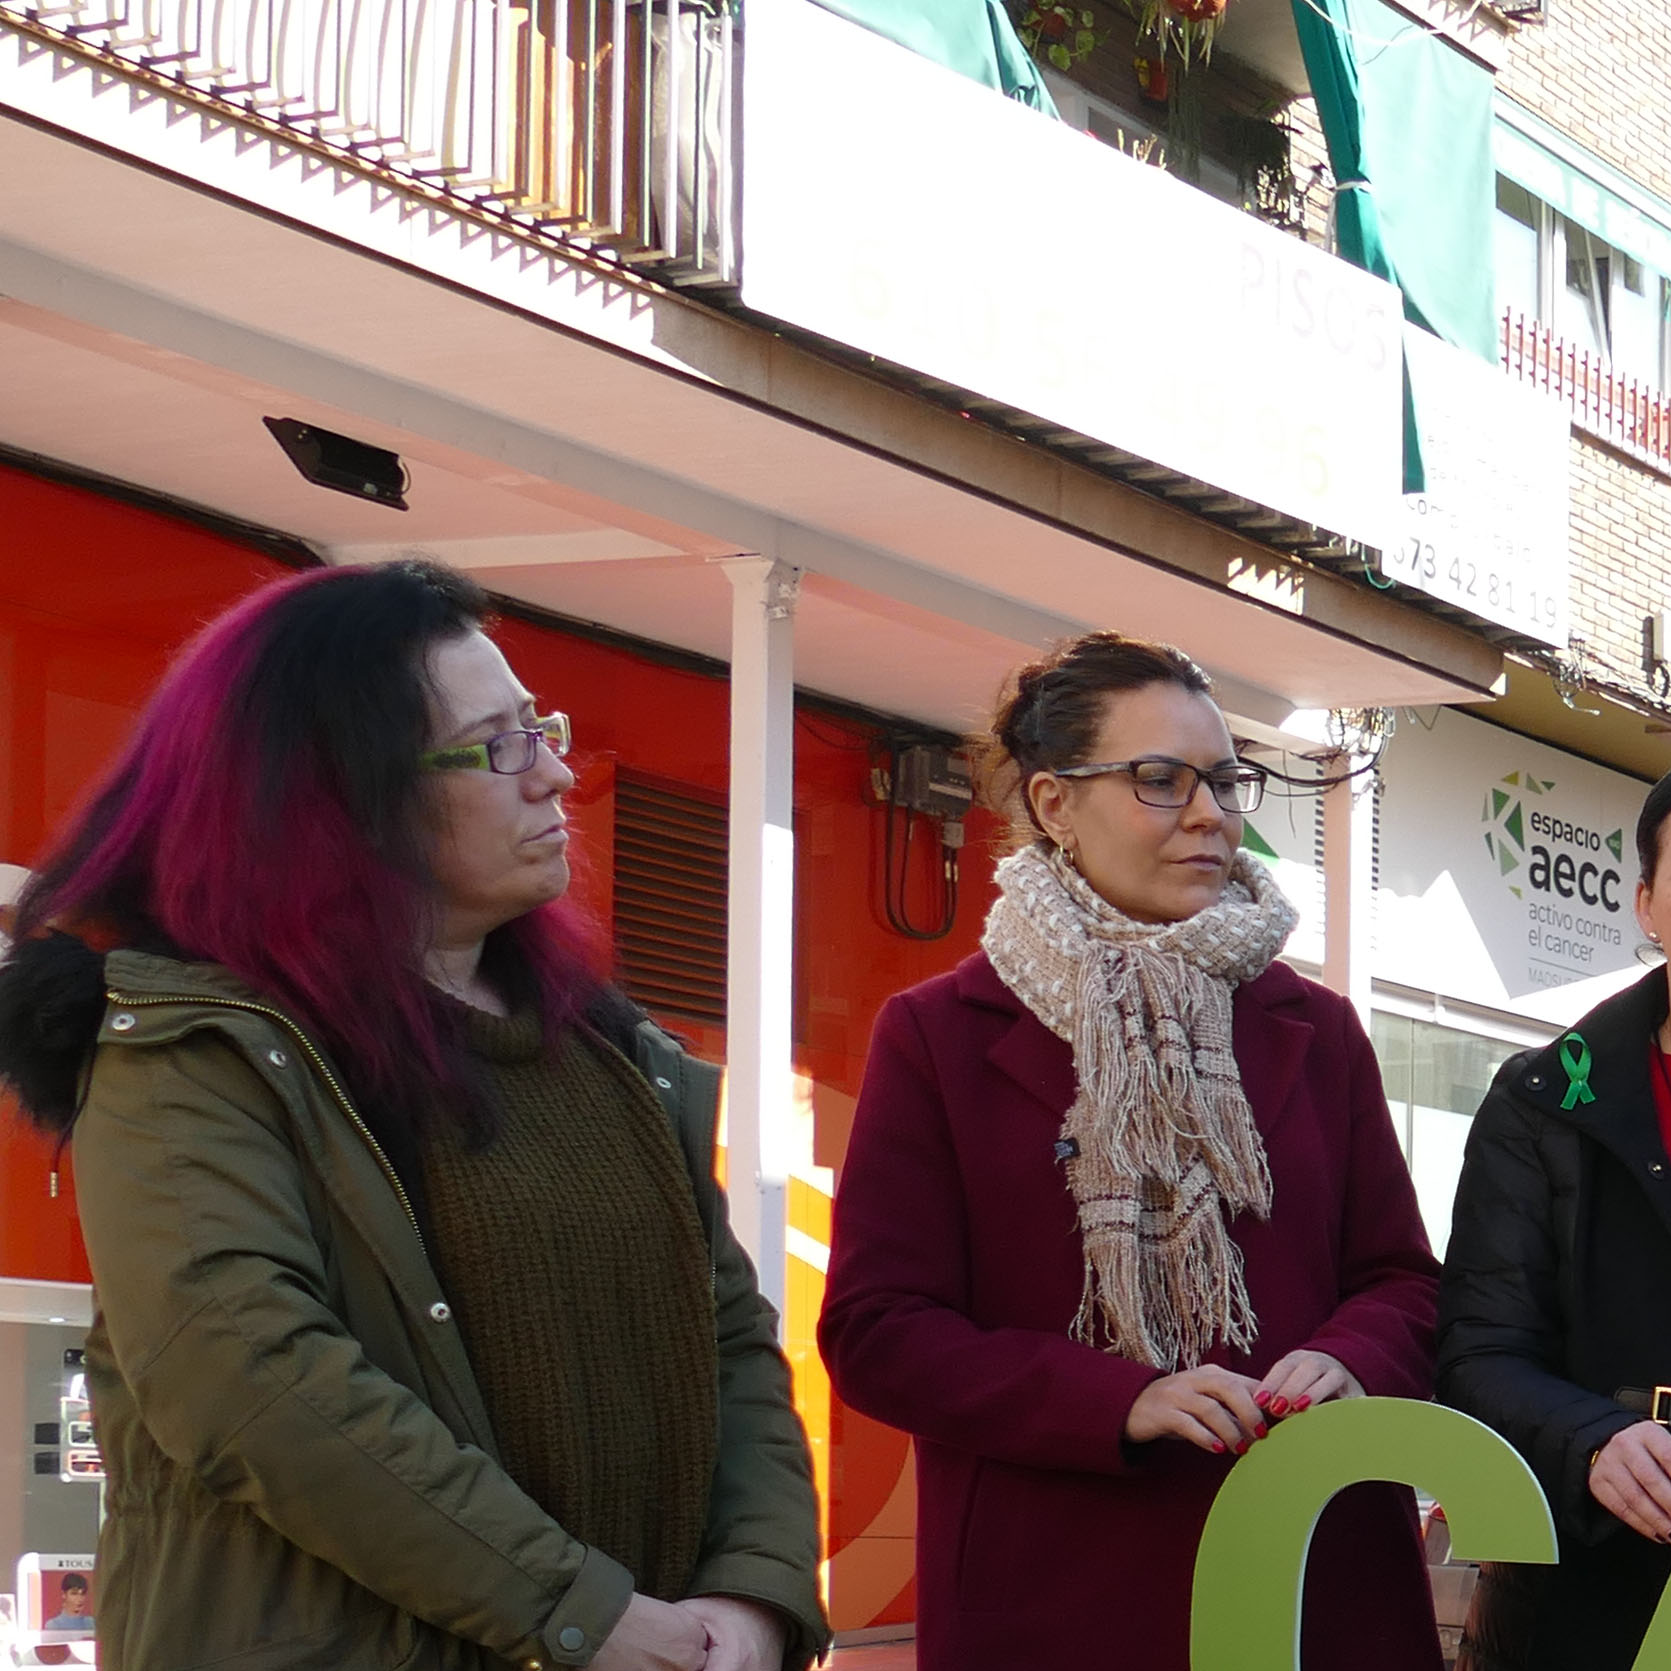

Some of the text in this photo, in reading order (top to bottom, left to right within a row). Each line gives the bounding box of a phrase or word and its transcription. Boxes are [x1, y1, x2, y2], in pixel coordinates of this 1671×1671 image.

[1448, 556, 1478, 598] 42
[1487, 572, 1517, 615] 81
[1529, 589, 1558, 630] 19
[1531, 811, 1601, 852] espacio
[1529, 845, 1621, 913] aecc
[1529, 901, 1622, 946] activo contra
[1529, 926, 1542, 948] el
